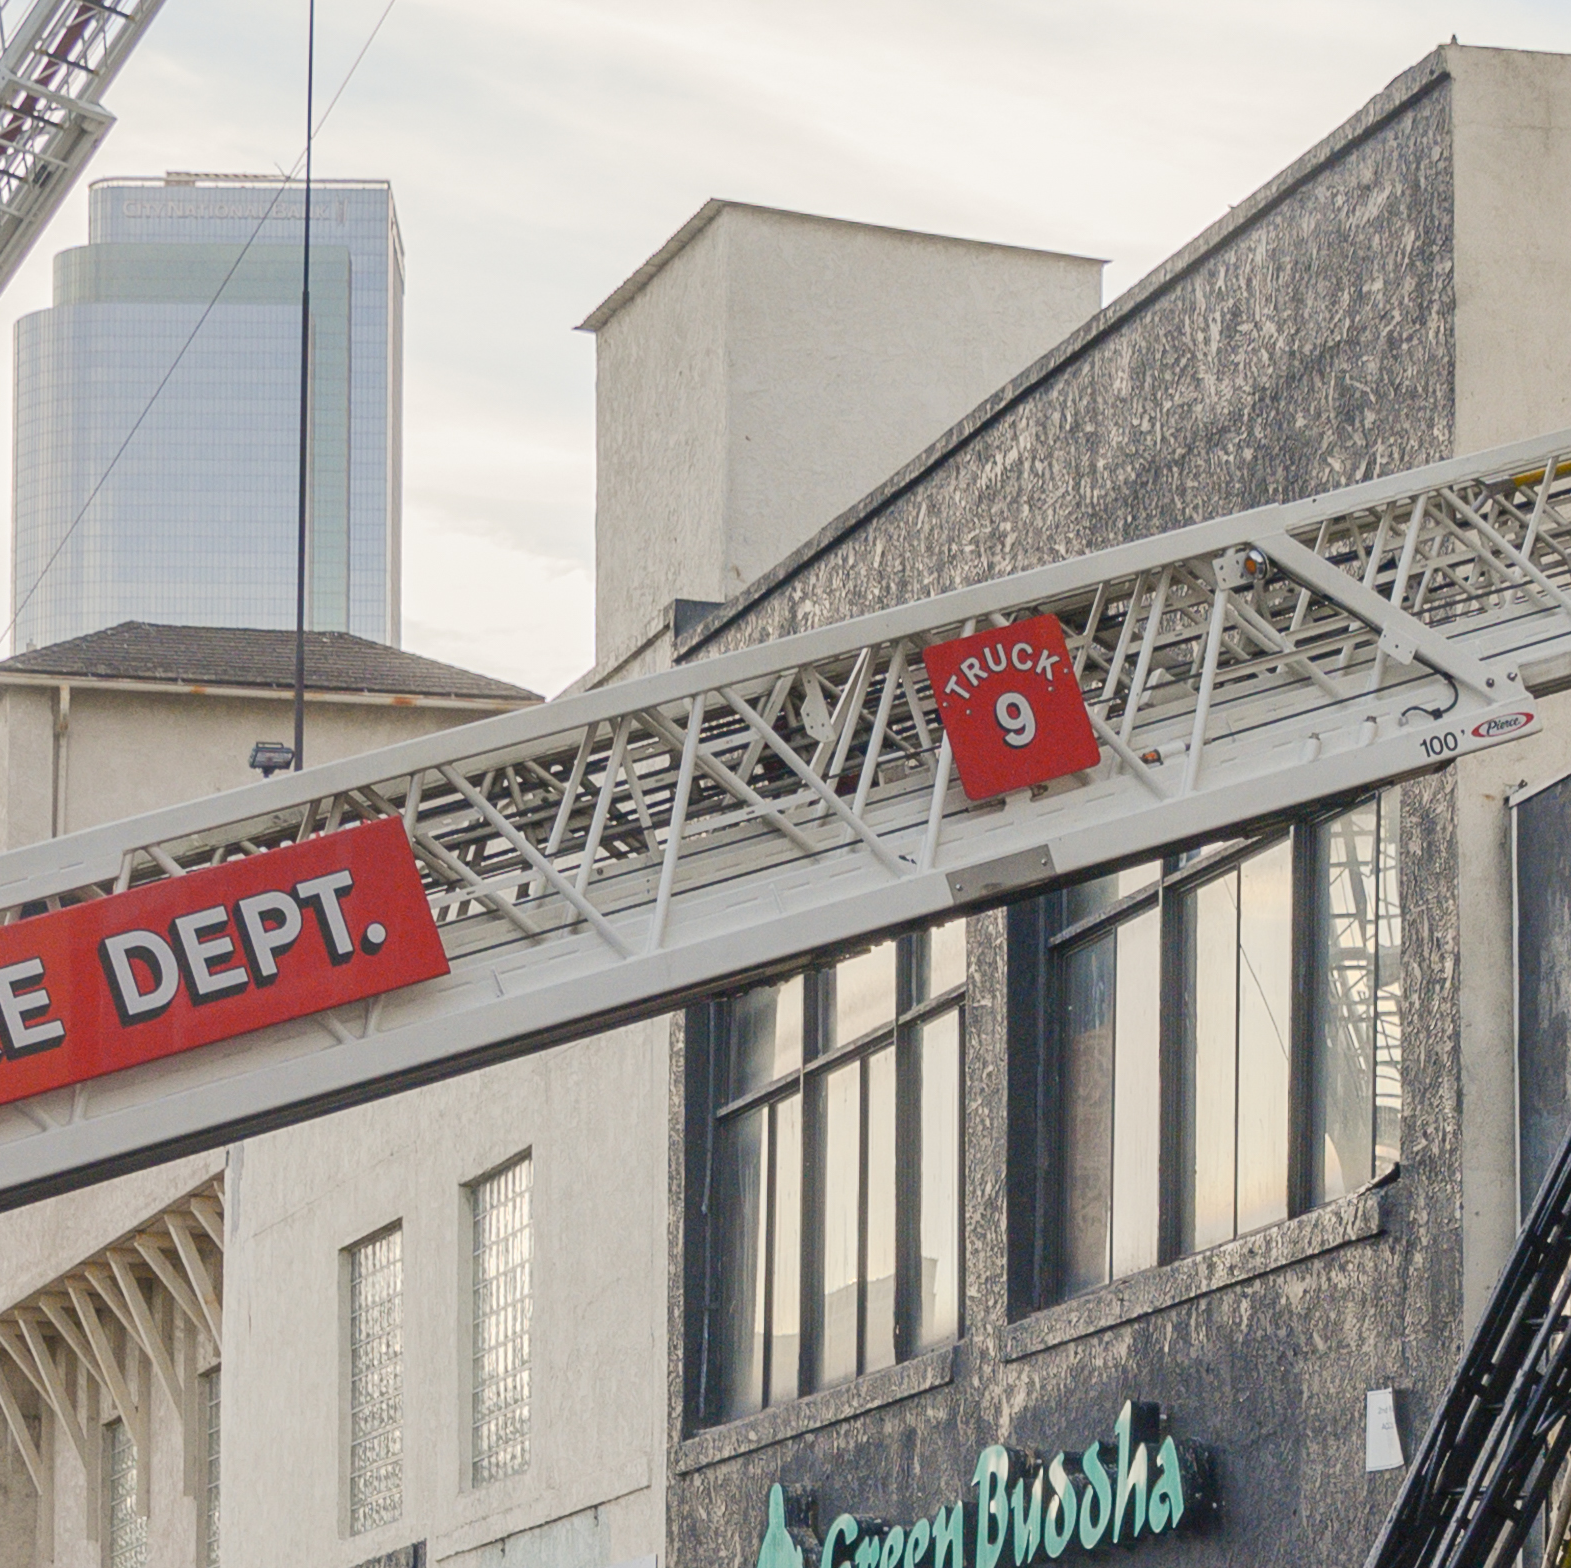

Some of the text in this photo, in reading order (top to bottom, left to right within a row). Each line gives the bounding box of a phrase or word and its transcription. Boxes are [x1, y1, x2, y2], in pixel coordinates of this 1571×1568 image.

[944, 642, 1061, 700] TRUCK
[995, 691, 1037, 750] 9
[1487, 717, 1520, 736] Pierce
[101, 868, 391, 1024] DEPT.
